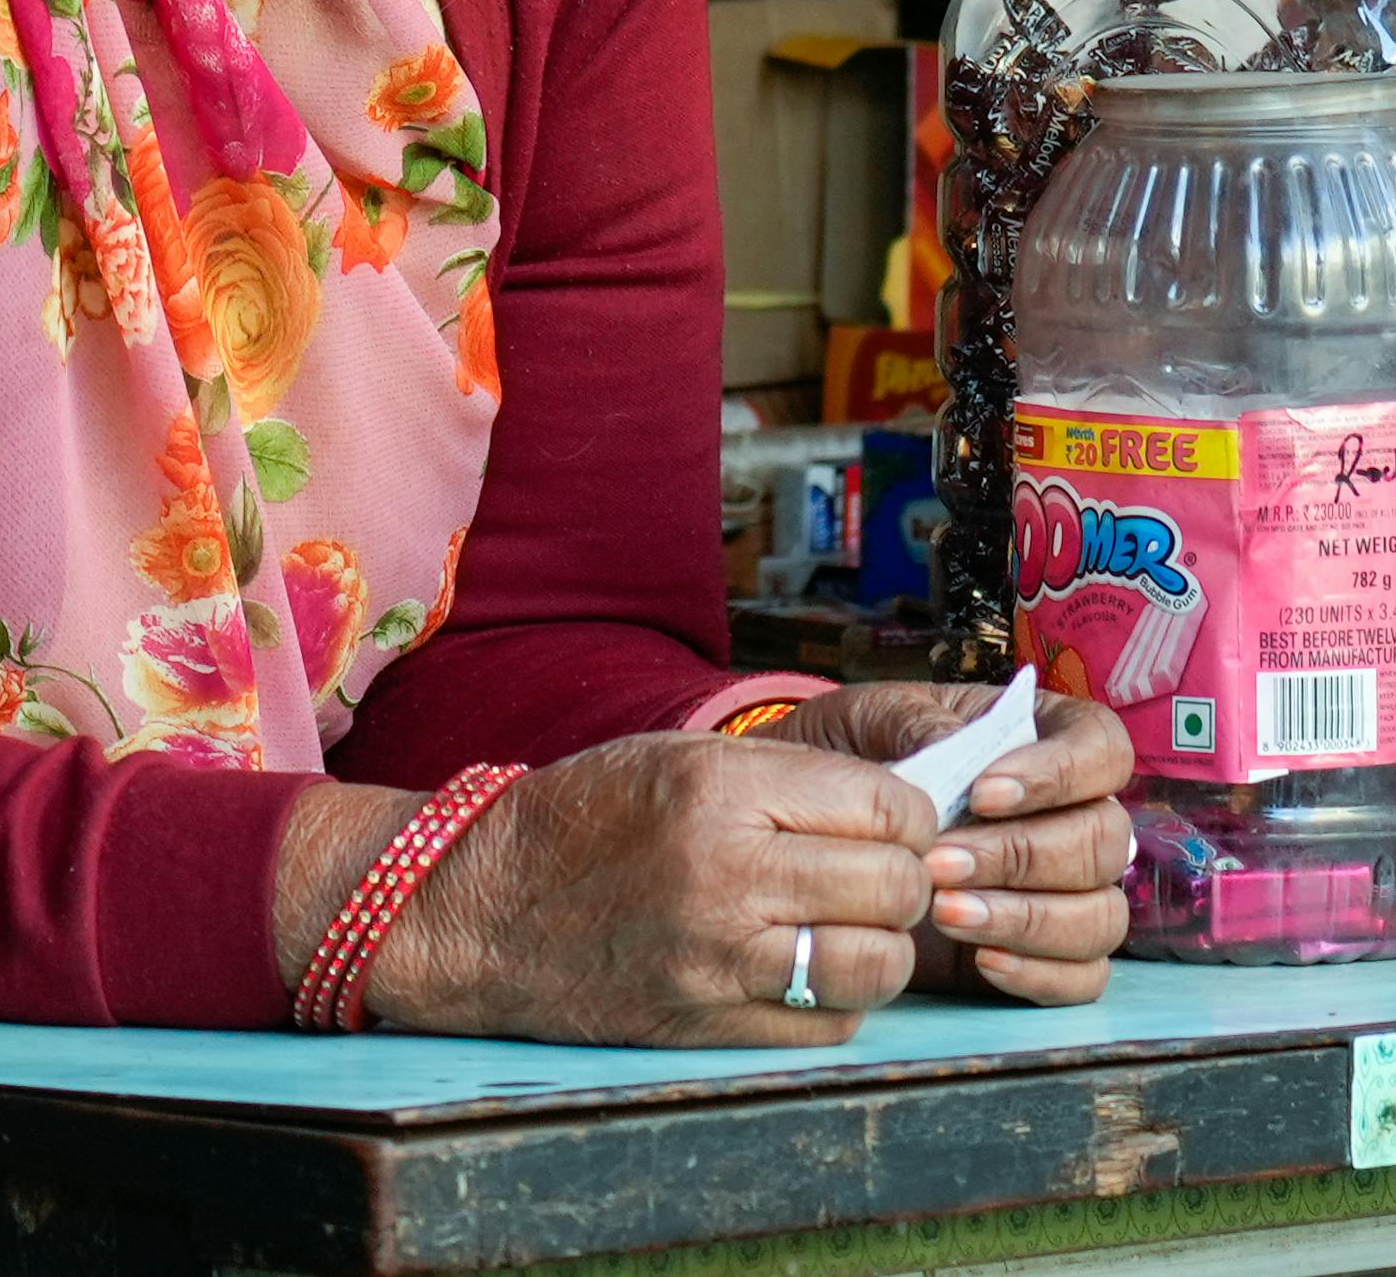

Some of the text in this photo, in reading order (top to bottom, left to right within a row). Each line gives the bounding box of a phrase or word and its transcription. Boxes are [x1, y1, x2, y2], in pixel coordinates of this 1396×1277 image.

[1028, 110, 1070, 178] Melody
[1066, 426, 1095, 441] Worth
[1100, 428, 1199, 472] FREE
[1313, 503, 1352, 521] 230.00
[1318, 538, 1350, 557] NET
[1352, 571, 1392, 590] 782 g
[1139, 576, 1198, 611] Bubble Gum
[1057, 591, 1134, 631] STRAWBERRY
[1279, 606, 1314, 625] (230
[1319, 604, 1363, 623] UNITS
[1367, 608, 1374, 620] x
[1259, 631, 1298, 650] BEST
[1302, 629, 1353, 648] BEFORE
[1259, 650, 1303, 669] FROM
